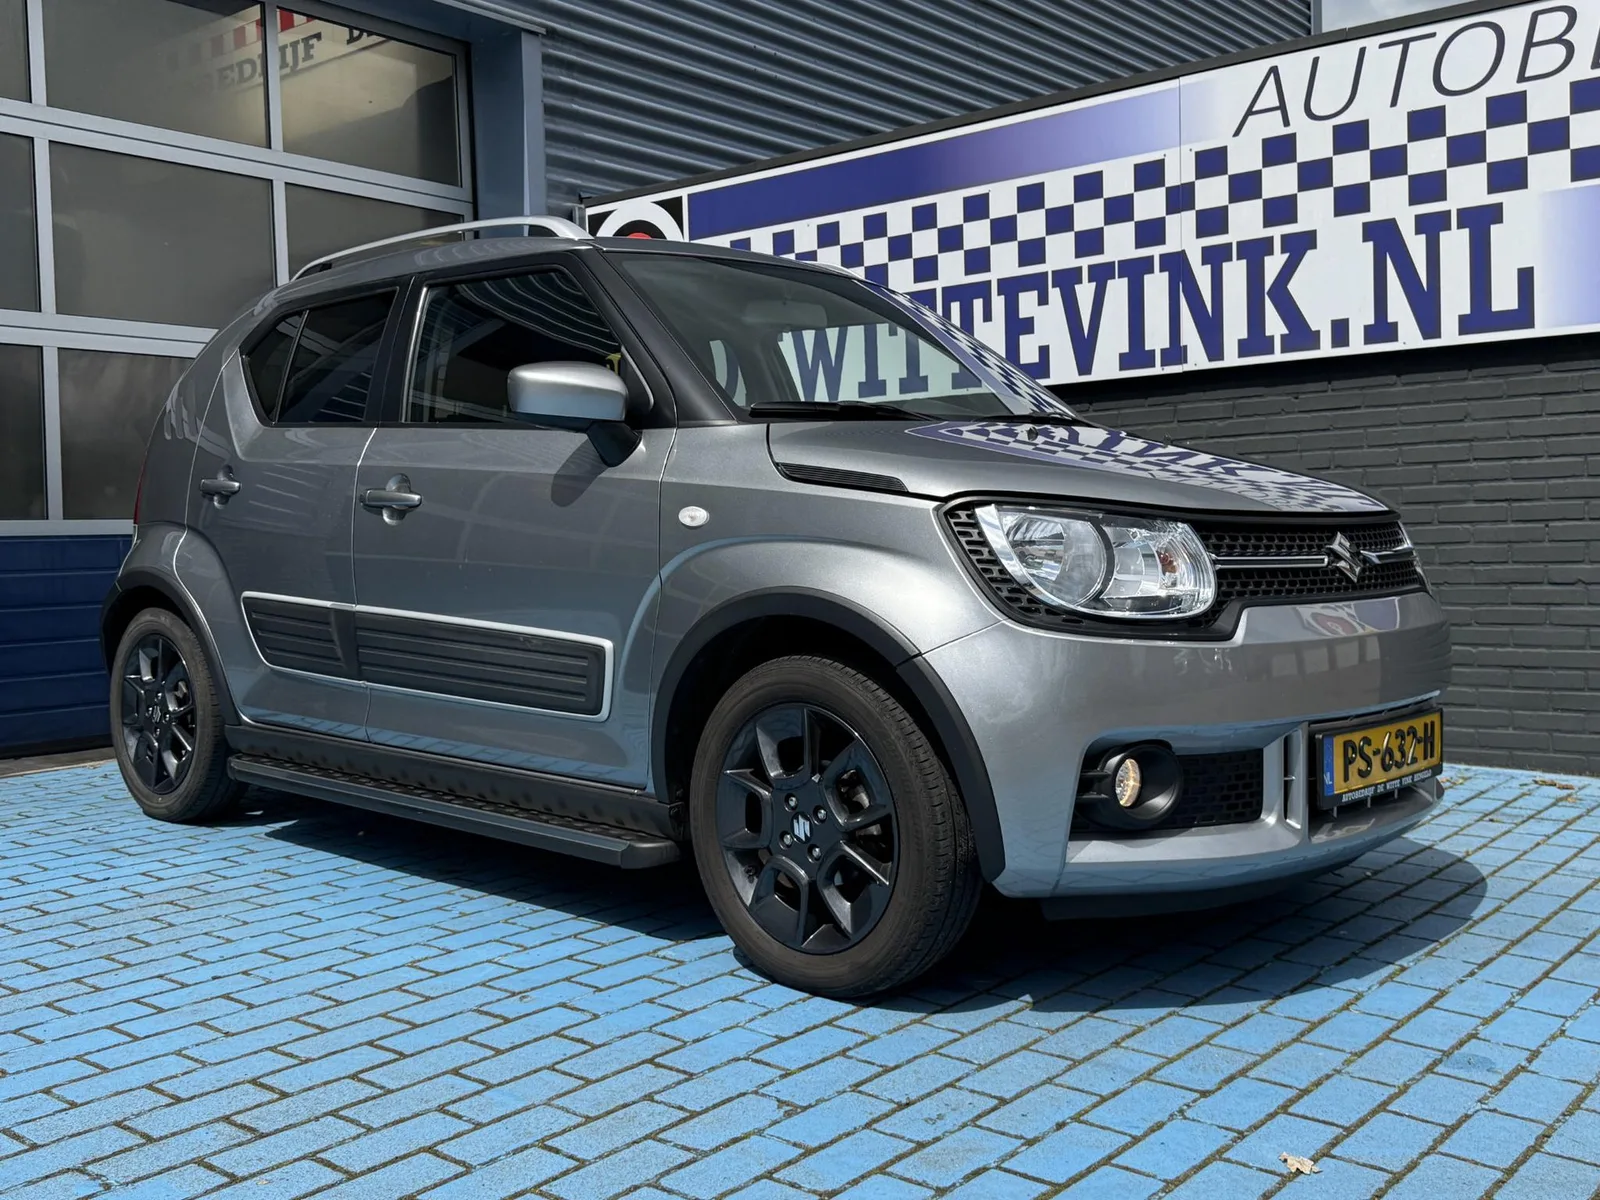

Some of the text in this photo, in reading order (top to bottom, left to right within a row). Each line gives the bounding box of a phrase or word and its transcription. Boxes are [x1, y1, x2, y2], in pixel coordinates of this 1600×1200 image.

[1233, 4, 1600, 138] AUTOB
[1323, 771, 1333, 785] NL
[1343, 721, 1435, 782] PS-632-H
